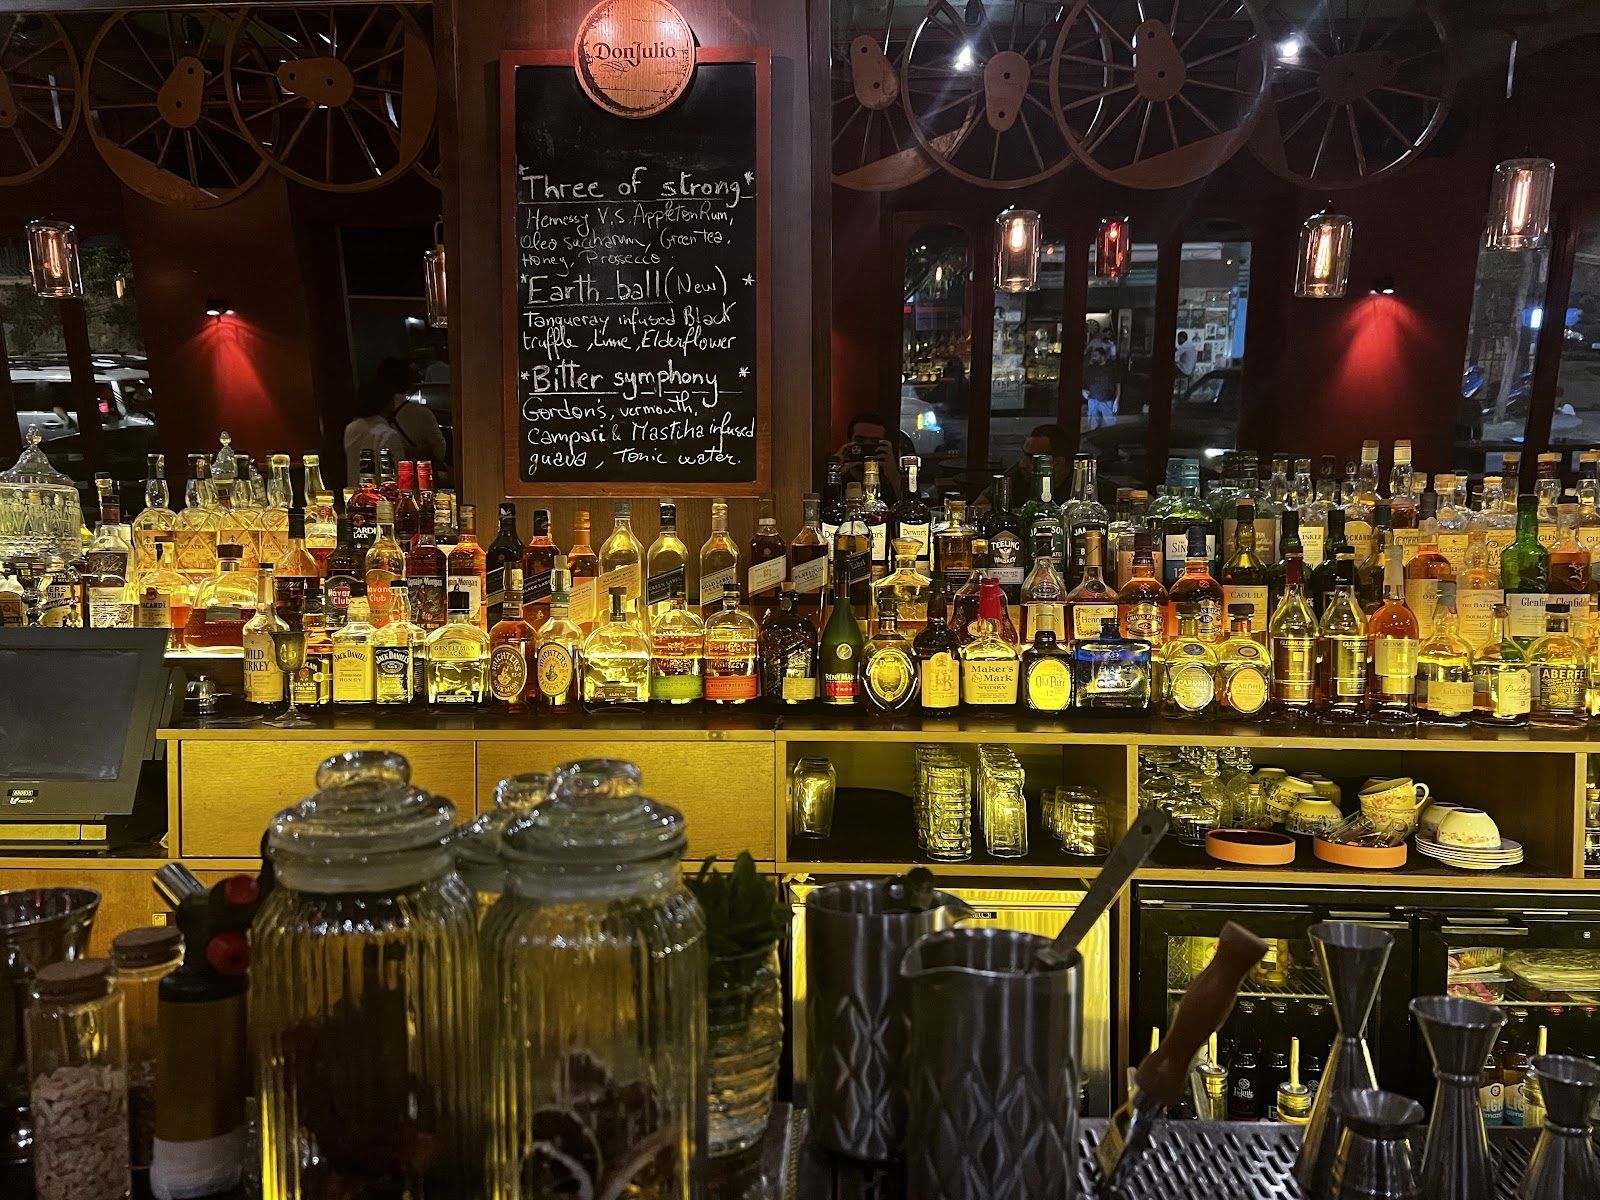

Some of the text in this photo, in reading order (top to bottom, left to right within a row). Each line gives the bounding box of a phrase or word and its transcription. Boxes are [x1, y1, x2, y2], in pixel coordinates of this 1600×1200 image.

[522, 175, 604, 199] Three
[618, 167, 647, 195] of
[528, 274, 600, 303] Earth
[532, 359, 604, 393] Bitter
[991, 541, 1020, 551] TEELING
[524, 581, 538, 593] LACK
[369, 593, 387, 602] Club
[1230, 591, 1252, 599] CAOL
[1521, 597, 1546, 607] Glenfi
[1555, 597, 1588, 607] Glenfidd
[1081, 615, 1100, 624] Henn
[334, 651, 347, 663] JACK
[244, 660, 270, 672] URKEY
[971, 665, 1014, 673] Maker's
[984, 674, 1013, 682] Mark
[1542, 668, 1586, 679] ABERFE
